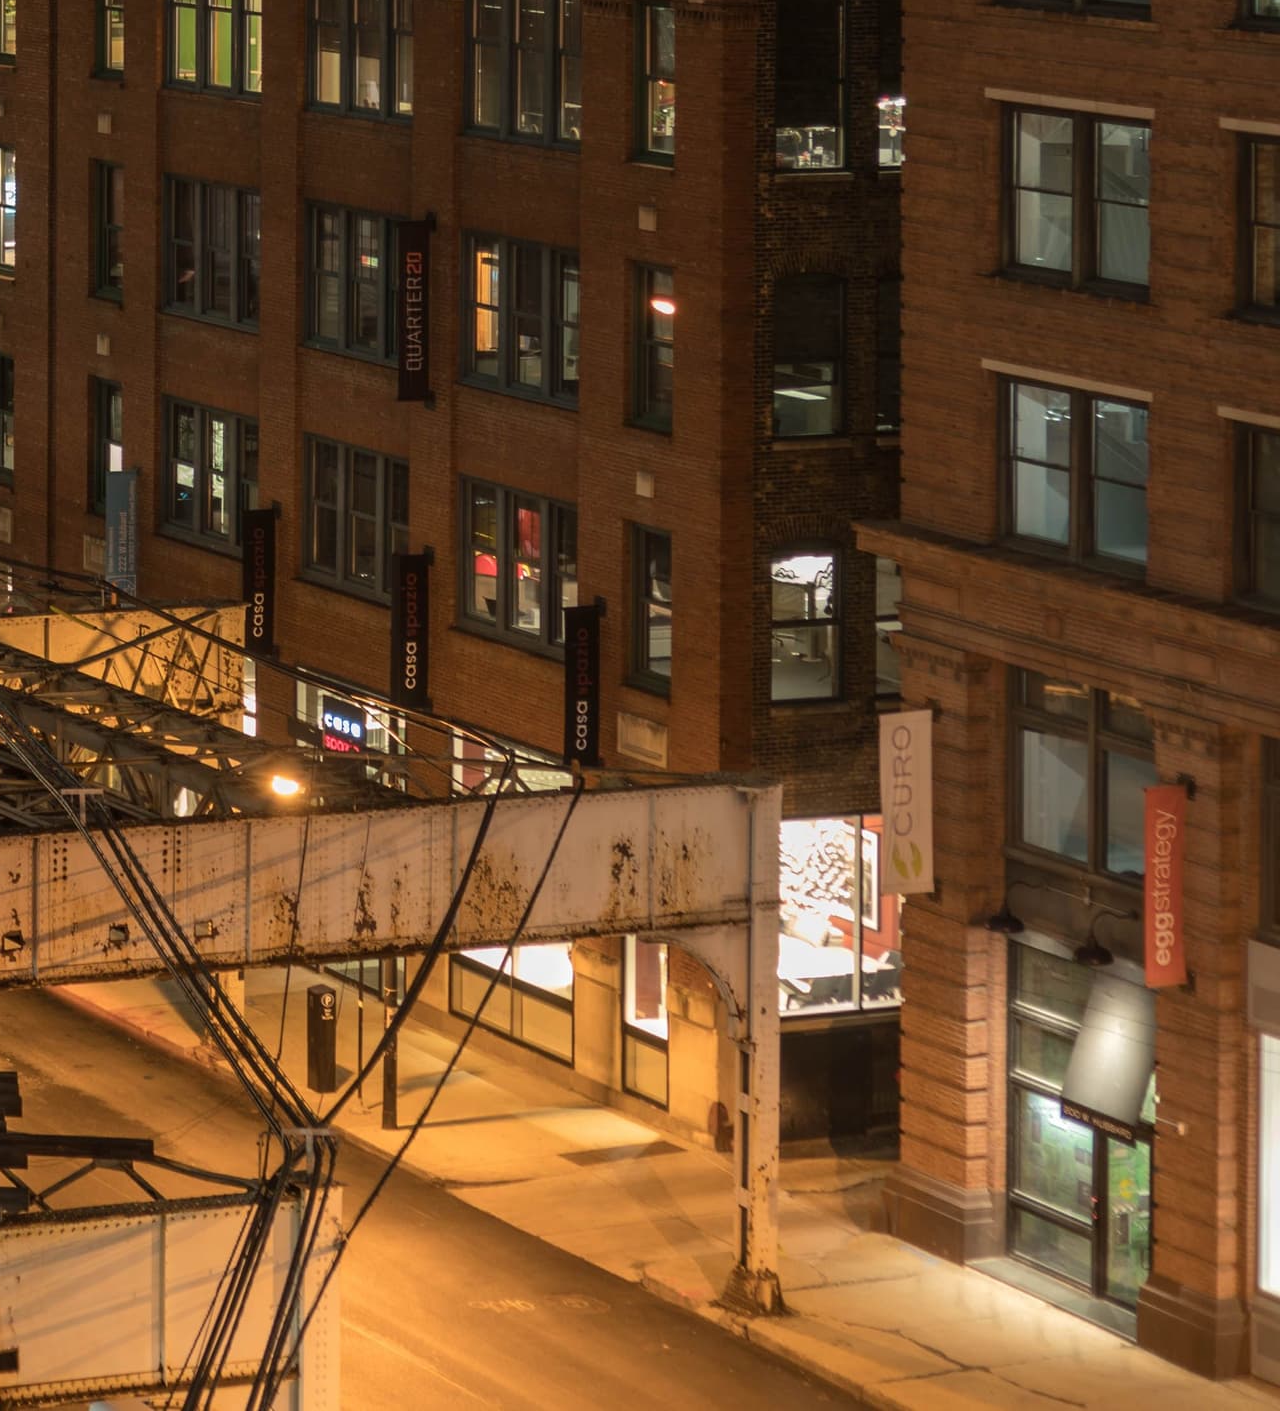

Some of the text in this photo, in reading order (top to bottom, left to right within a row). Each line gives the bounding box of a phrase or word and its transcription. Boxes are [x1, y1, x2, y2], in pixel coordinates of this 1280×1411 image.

[406, 251, 424, 371] QUARTER20
[252, 592, 265, 638] casa
[405, 641, 417, 690] casa
[324, 713, 361, 738] casa
[575, 700, 588, 751] casa
[892, 725, 913, 837] CURO
[1152, 809, 1177, 966] eggstrategy
